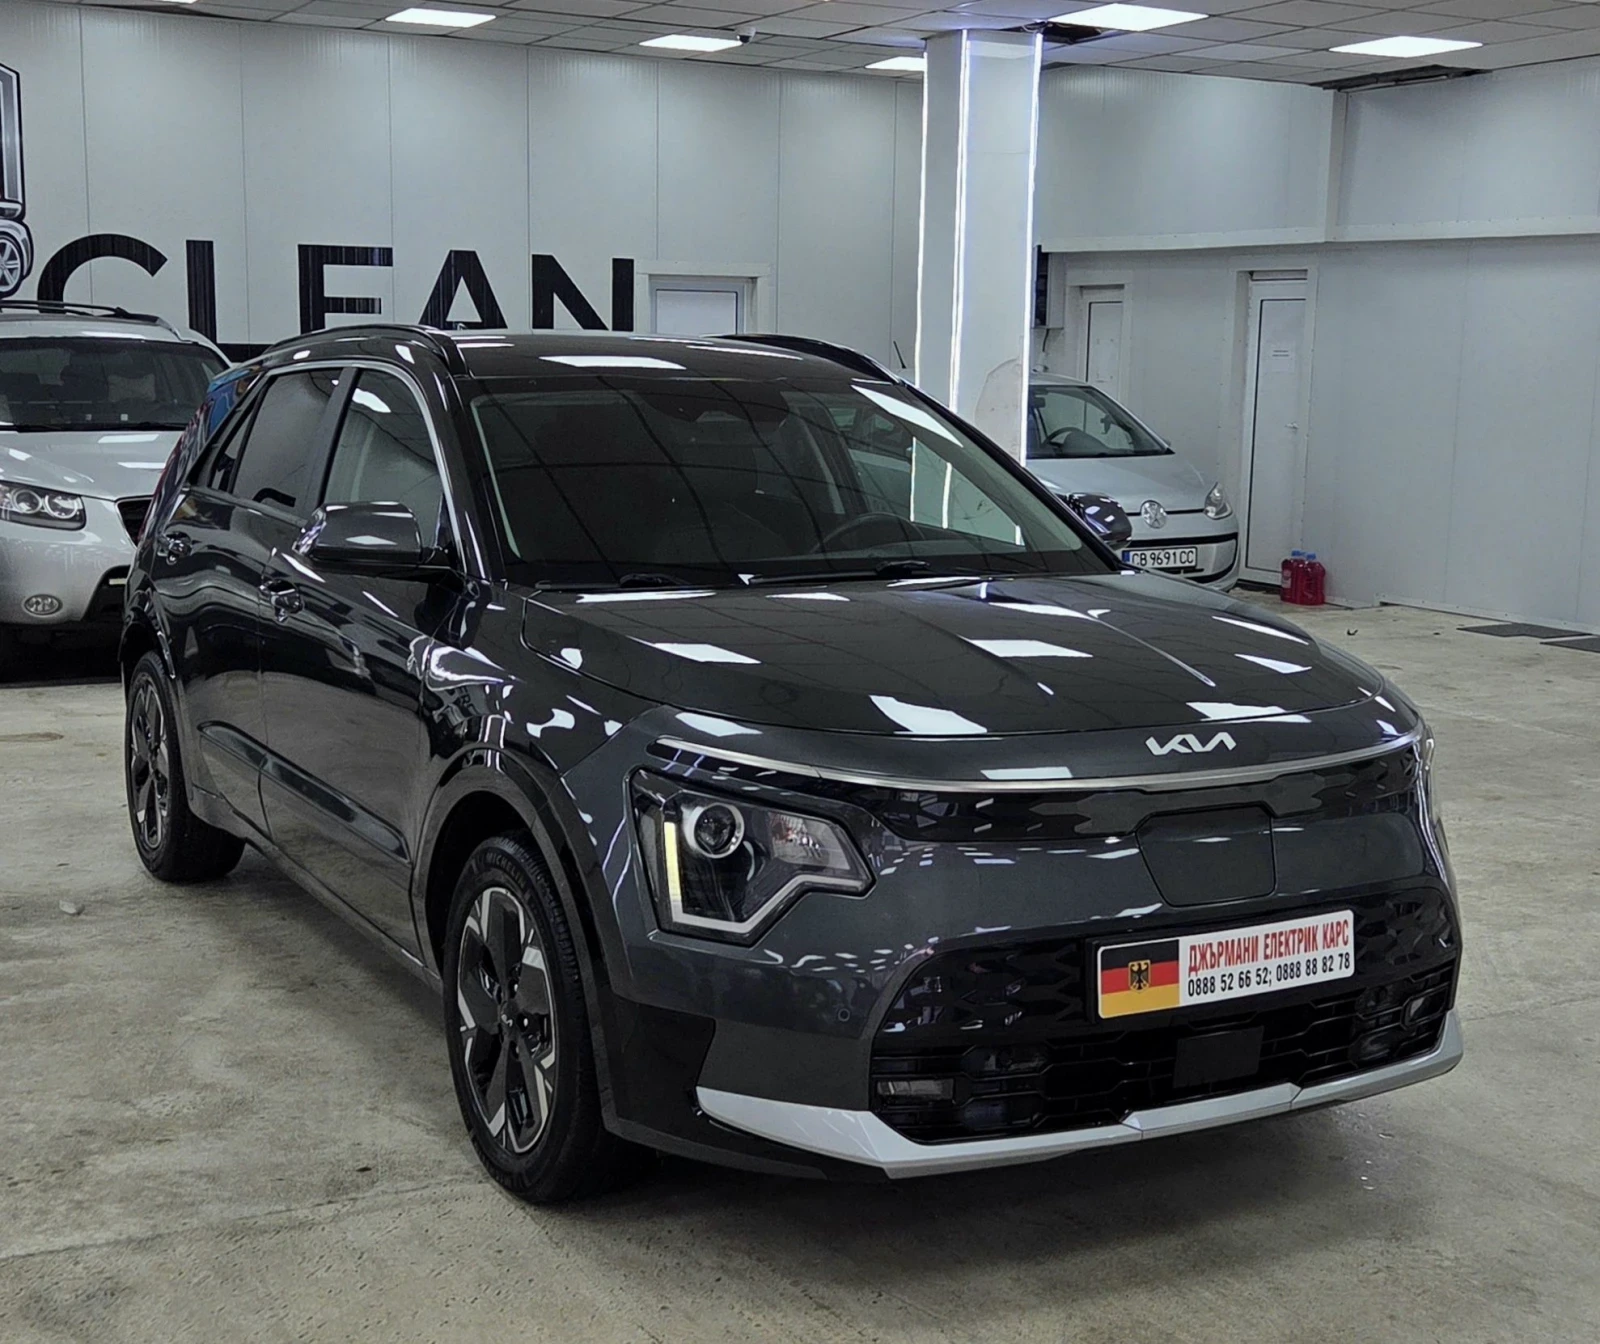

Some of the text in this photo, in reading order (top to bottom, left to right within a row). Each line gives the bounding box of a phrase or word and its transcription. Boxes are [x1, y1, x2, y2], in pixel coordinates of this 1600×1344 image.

[1150, 551, 1177, 566] 9691
[1145, 732, 1237, 756] KIA
[1188, 919, 1349, 978] ДЖЪРМАНИ ЕЛЕКТРИК КАРС
[1188, 951, 1351, 997] 0888 52 66 52; 0888 88 82 78
